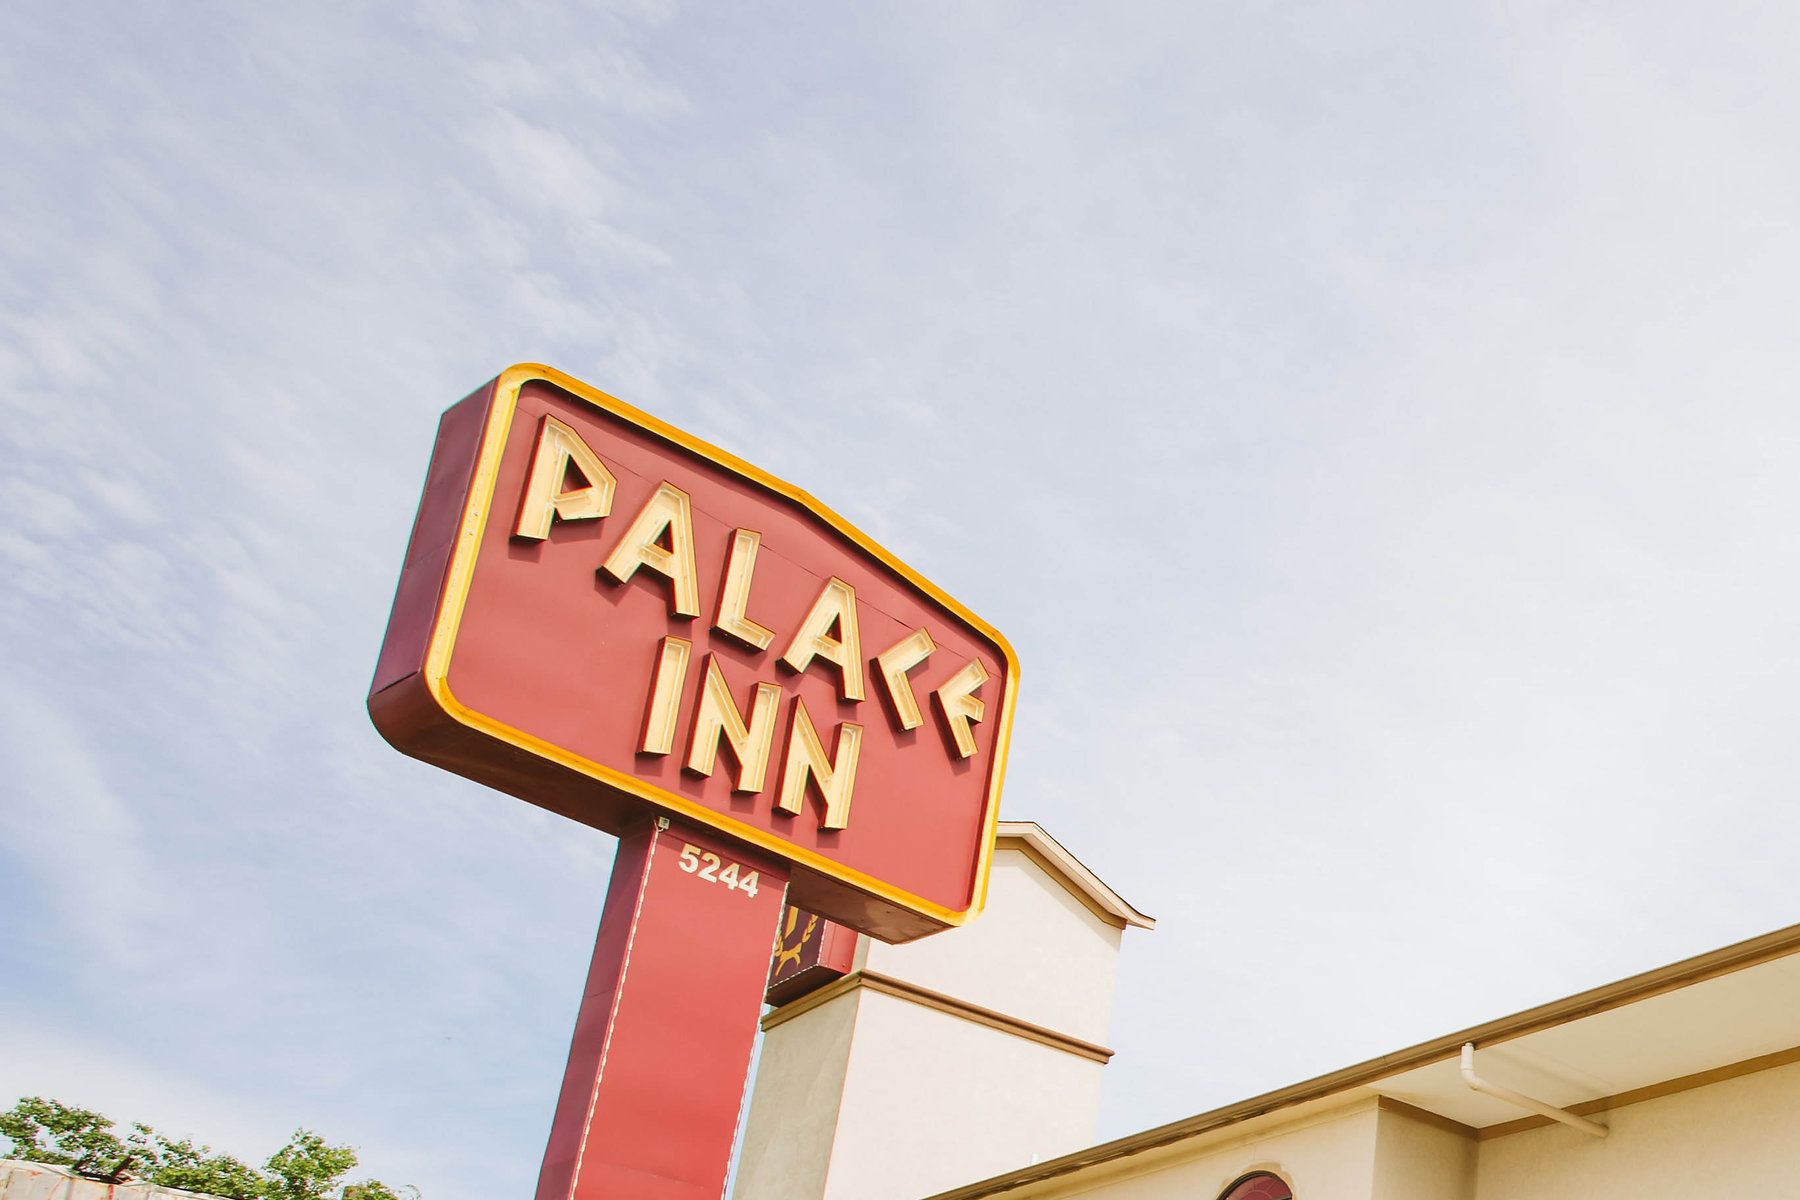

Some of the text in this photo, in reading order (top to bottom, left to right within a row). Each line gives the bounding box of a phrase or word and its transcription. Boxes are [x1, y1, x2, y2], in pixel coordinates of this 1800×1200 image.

[509, 412, 992, 762] PALACE
[634, 634, 866, 832] INN
[677, 842, 760, 900] 5244
